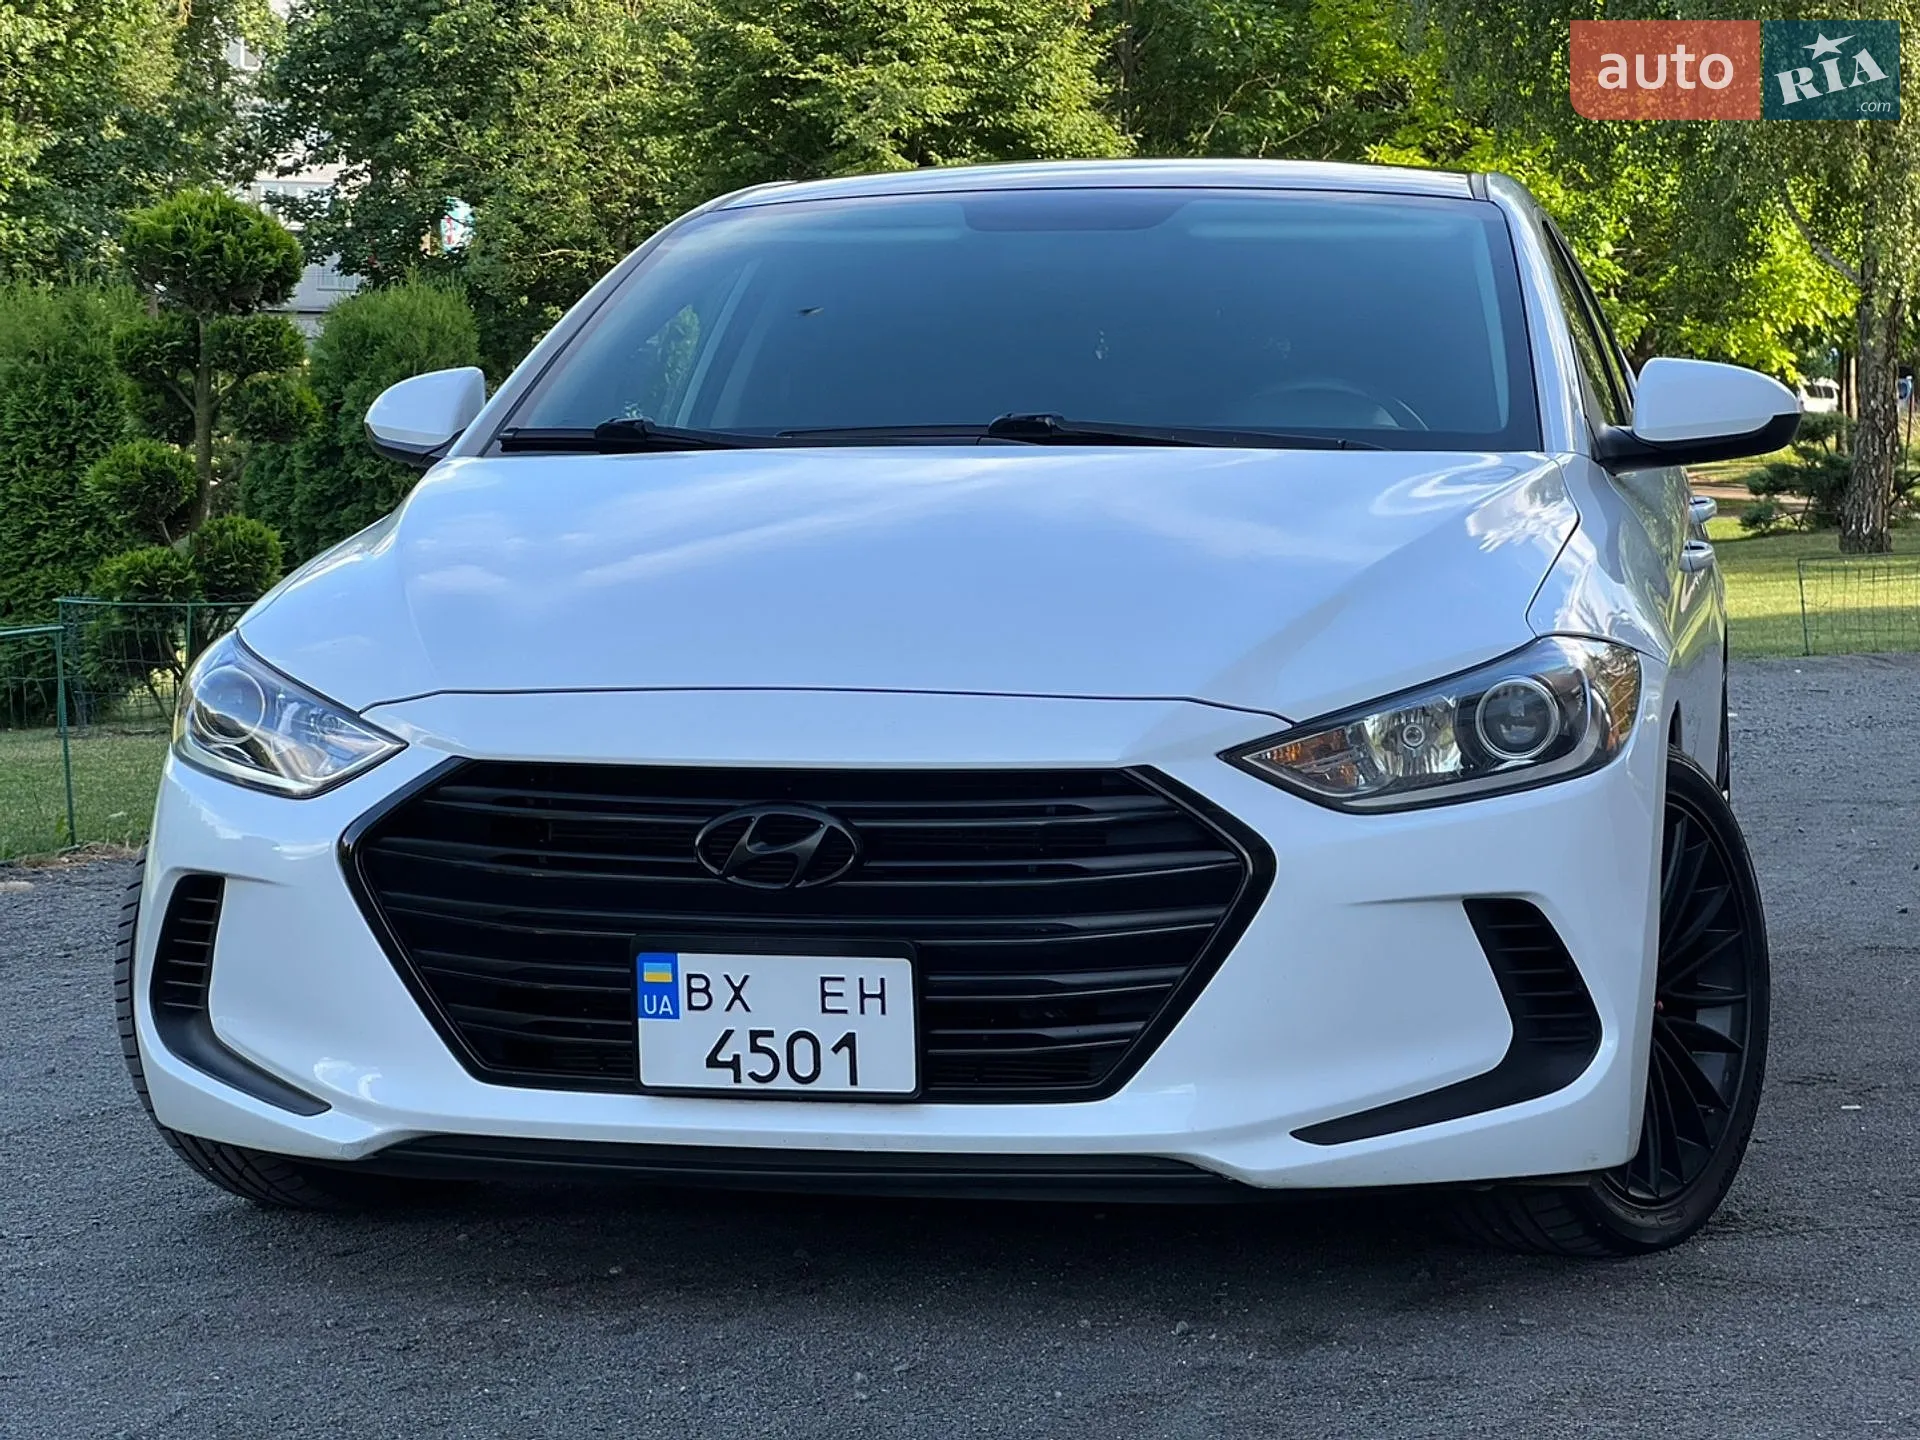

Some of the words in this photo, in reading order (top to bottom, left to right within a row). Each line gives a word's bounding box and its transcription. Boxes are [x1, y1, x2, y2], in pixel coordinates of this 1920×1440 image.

[643, 994, 673, 1015] UA
[686, 973, 751, 1013] BX
[820, 975, 886, 1015] EH
[705, 1029, 858, 1086] 4501
